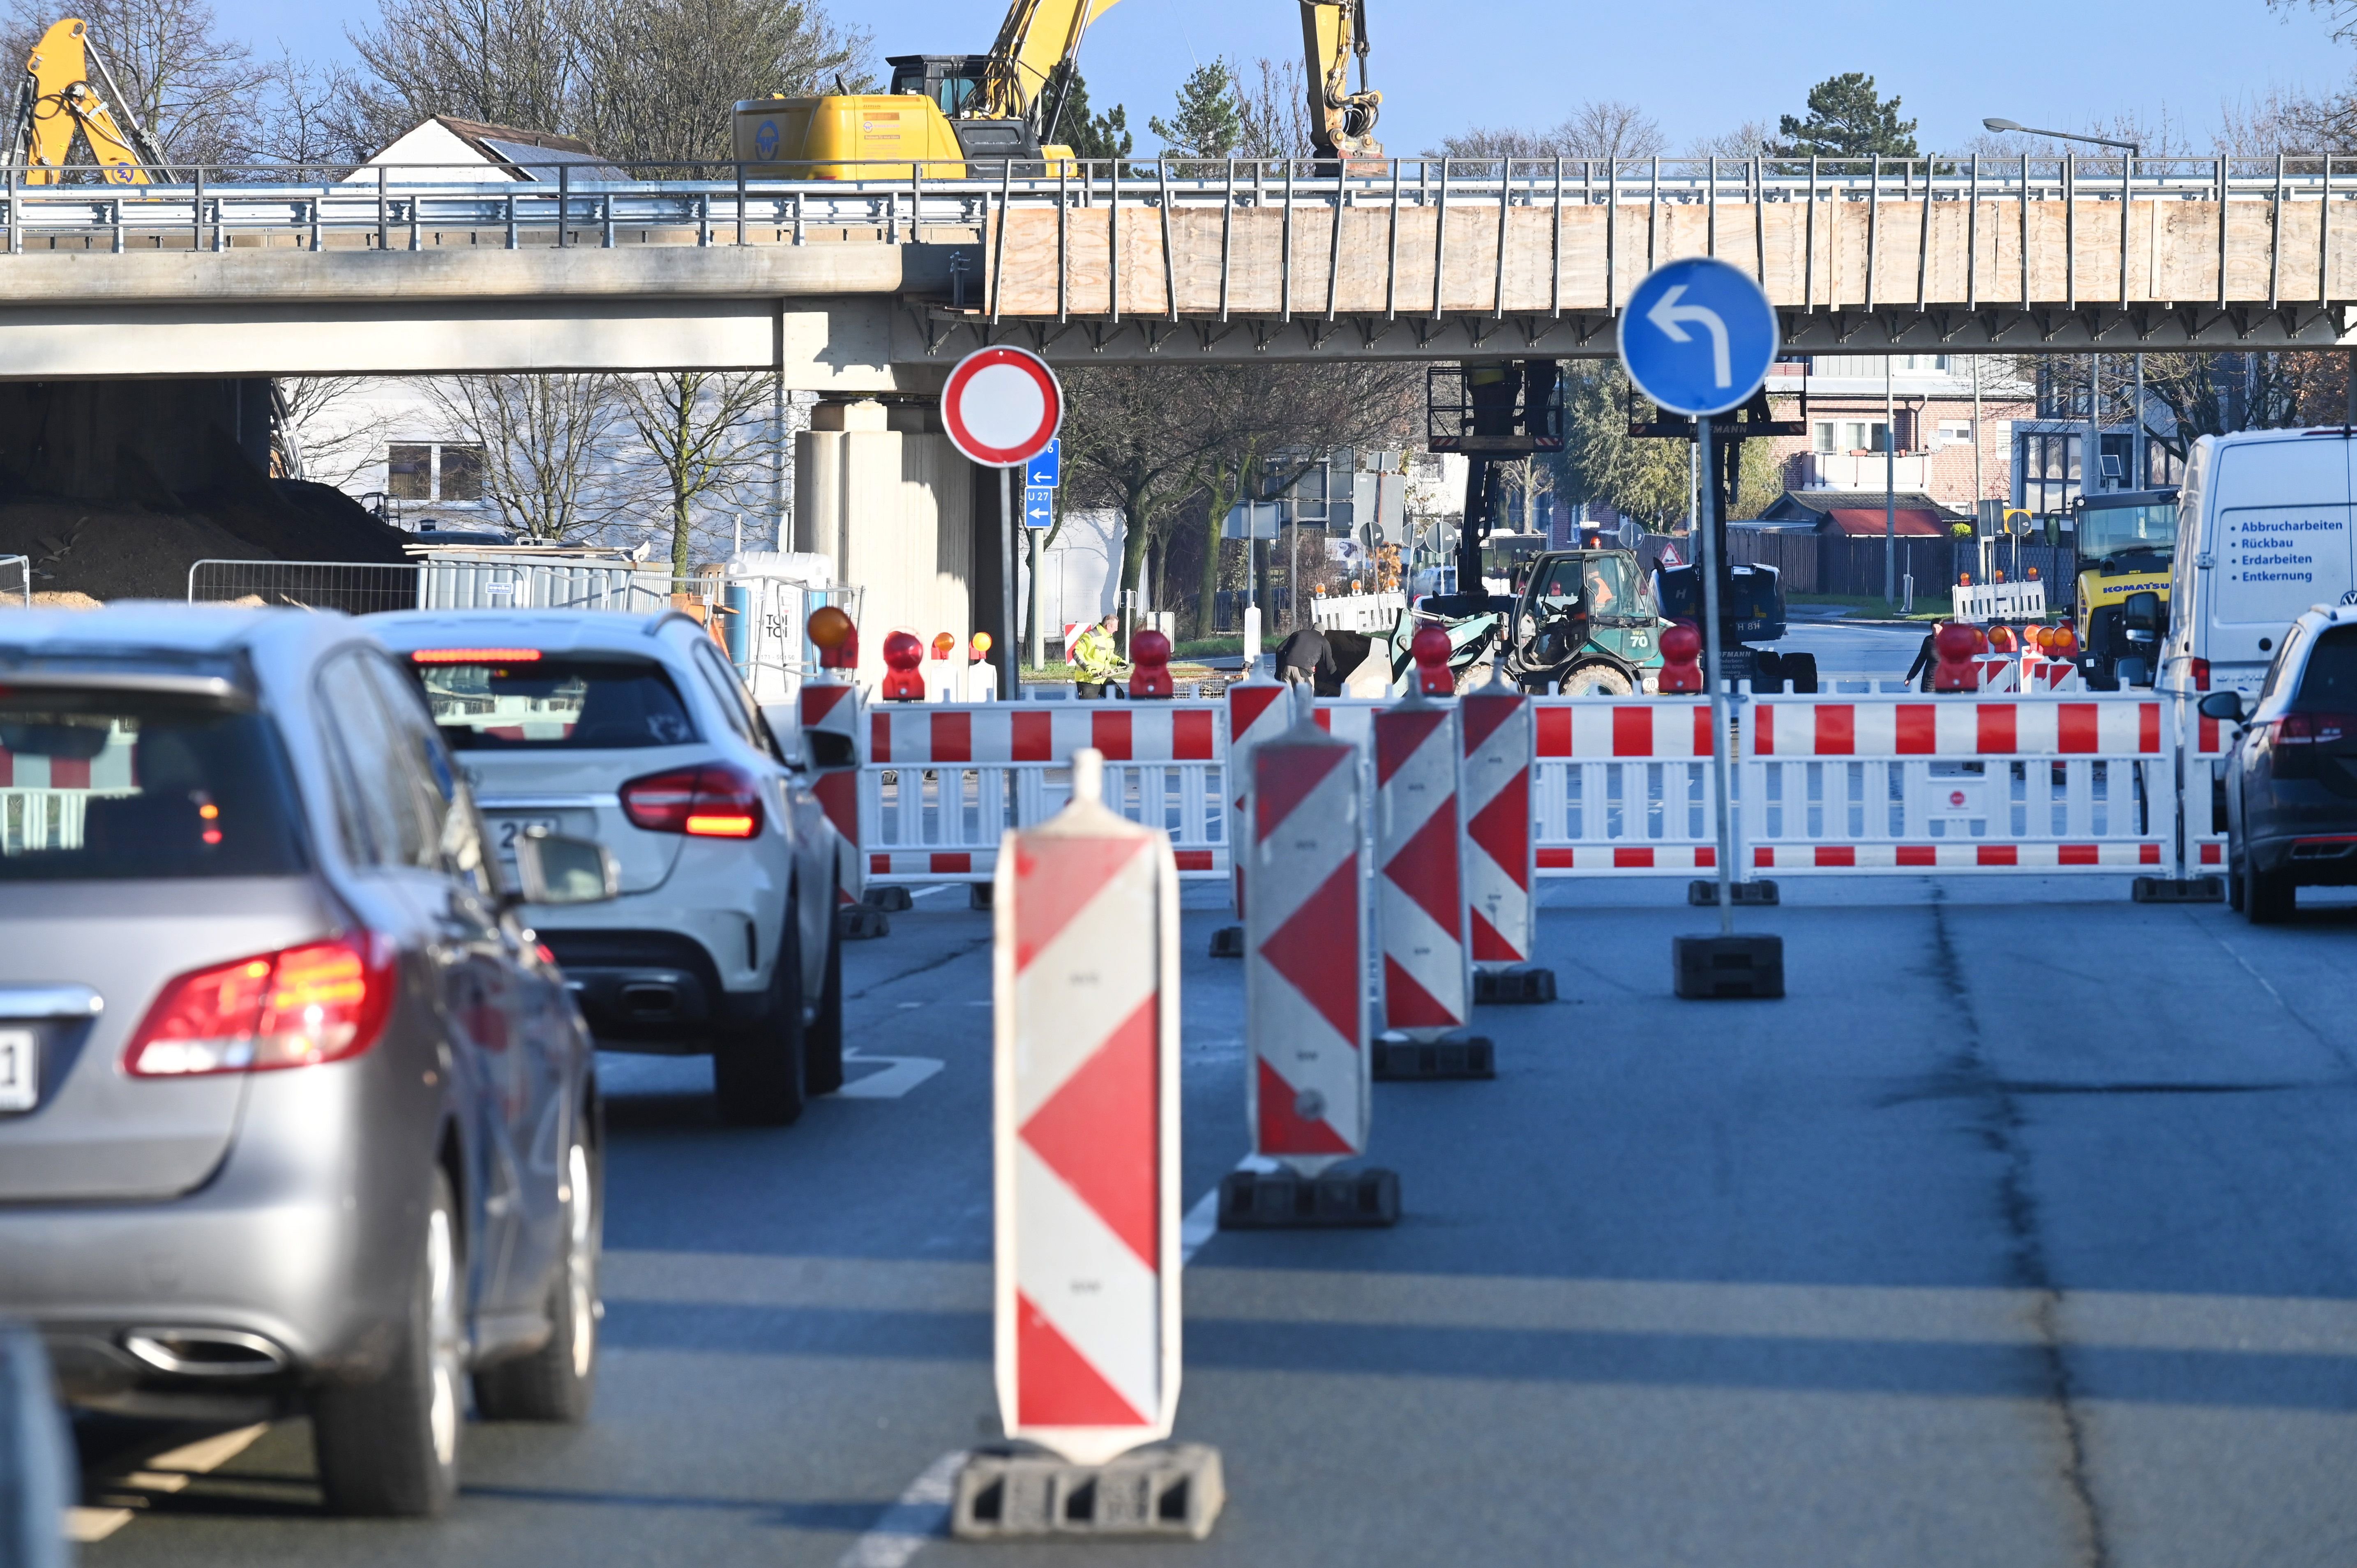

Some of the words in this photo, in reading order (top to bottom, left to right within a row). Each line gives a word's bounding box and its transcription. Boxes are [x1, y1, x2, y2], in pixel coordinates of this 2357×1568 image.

[1689, 425, 1748, 434] HMANN
[1028, 492, 1035, 501] U
[1037, 492, 1049, 501] 27
[2242, 520, 2343, 532] Abbrucharbeiten
[2242, 538, 2293, 549] Rückbau
[2242, 554, 2312, 565] Erdarbeiten
[2243, 572, 2312, 583] Entkernung
[1675, 588, 1687, 599] H
[2103, 582, 2170, 594] KOMATSU
[766, 614, 788, 625] TOI
[766, 626, 787, 638] TOI
[1630, 636, 1648, 648] 70
